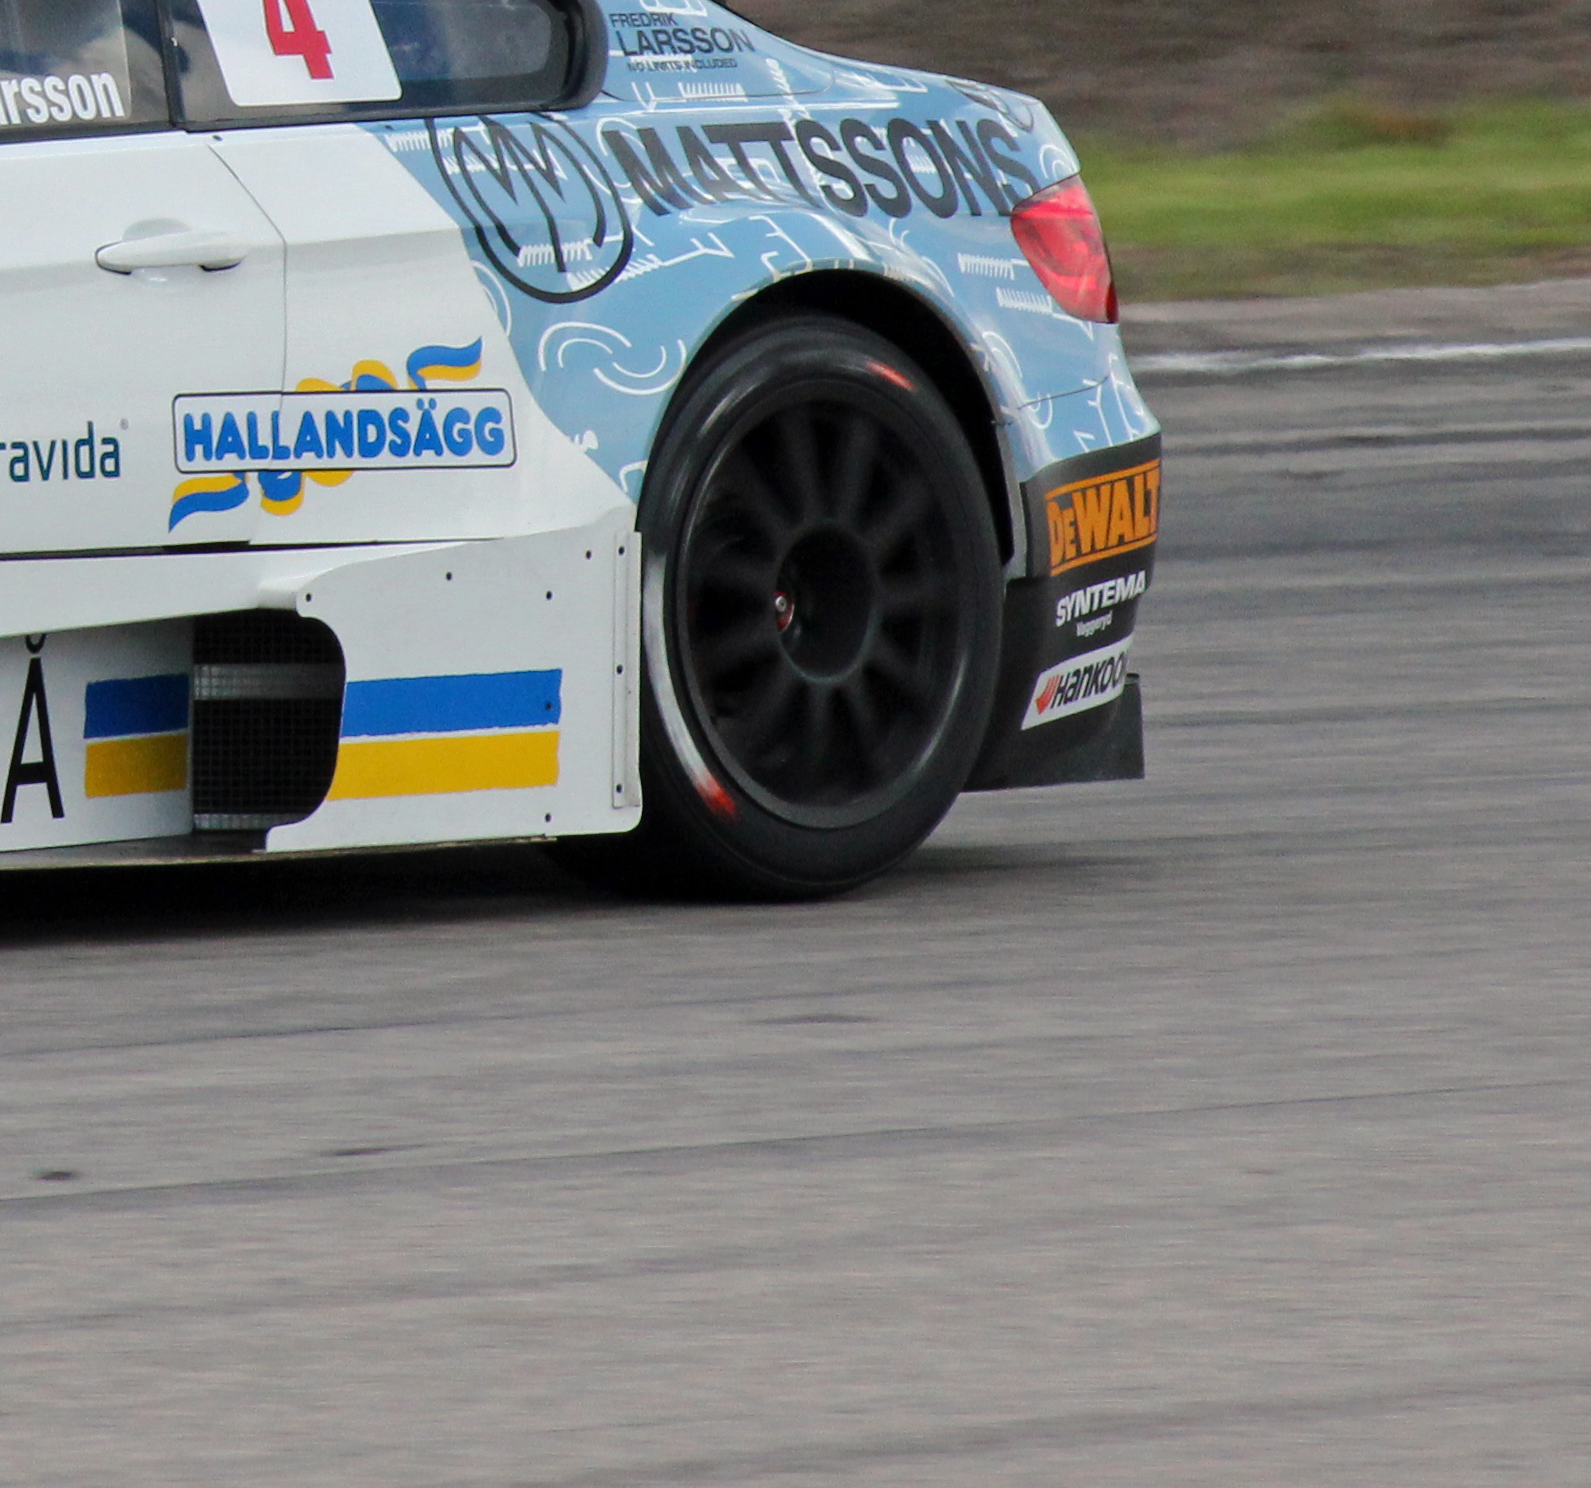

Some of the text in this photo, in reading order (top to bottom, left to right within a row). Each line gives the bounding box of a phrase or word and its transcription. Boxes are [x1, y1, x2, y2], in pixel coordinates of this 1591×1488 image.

[609, 13, 679, 28] FREDRIK
[615, 26, 756, 56] LARSSON
[603, 118, 1042, 219] MATTSSONS
[183, 398, 505, 462] HALLANDSÄGG
[1055, 570, 1146, 628] SYNTEMA
